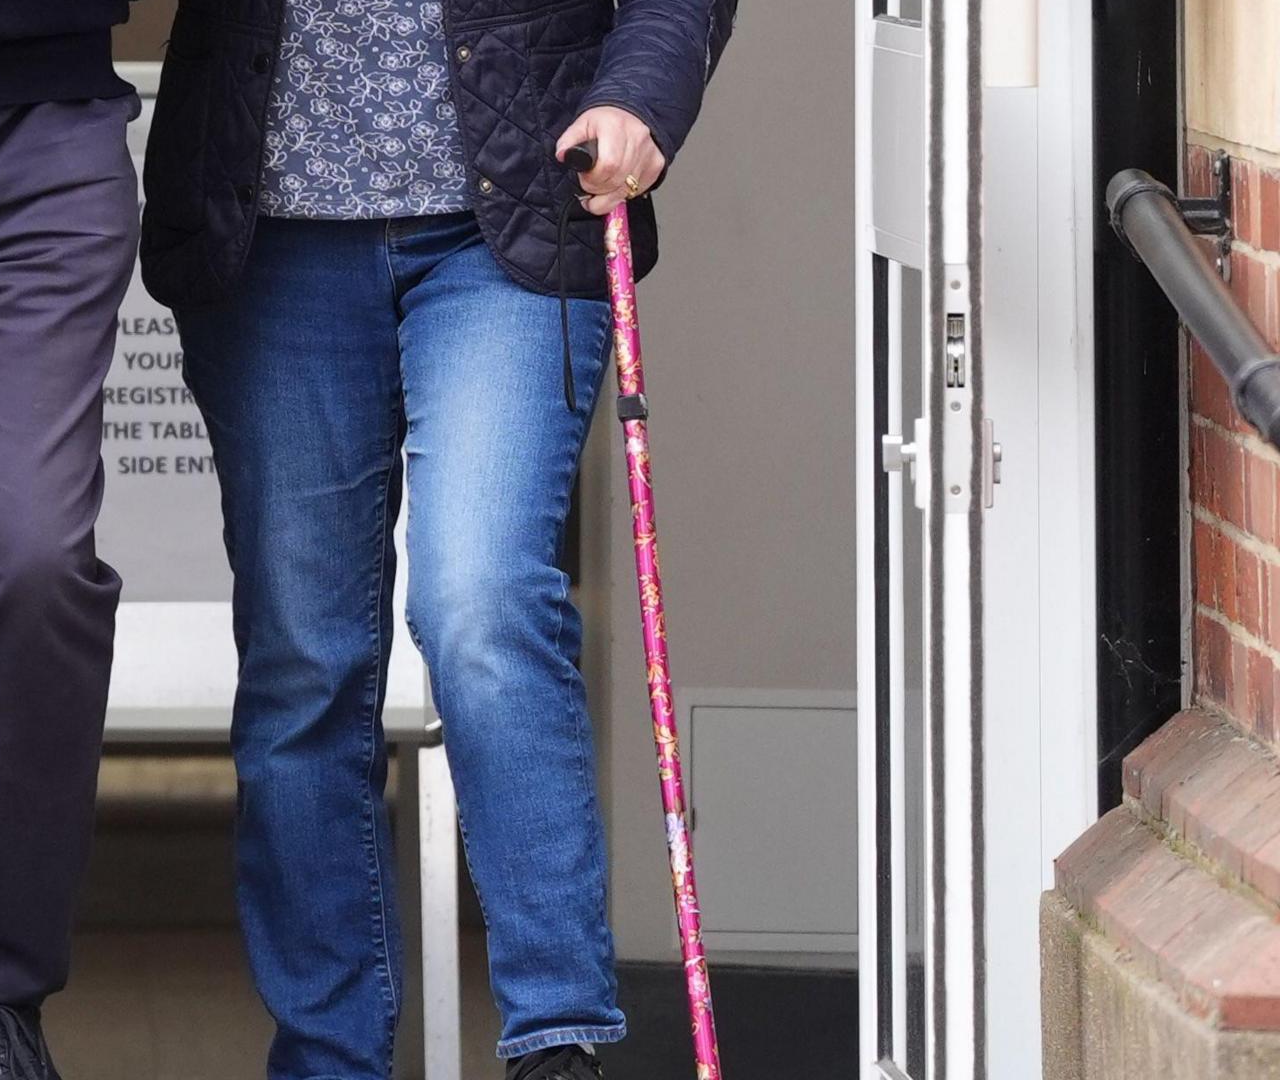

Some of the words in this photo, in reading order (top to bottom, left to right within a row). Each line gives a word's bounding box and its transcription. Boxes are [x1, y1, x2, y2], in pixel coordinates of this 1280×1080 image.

[117, 317, 180, 336] LEAS
[103, 387, 196, 405] REGISTR
[103, 422, 142, 439] THE
[150, 422, 210, 439] TABL
[118, 456, 167, 474] SIDE
